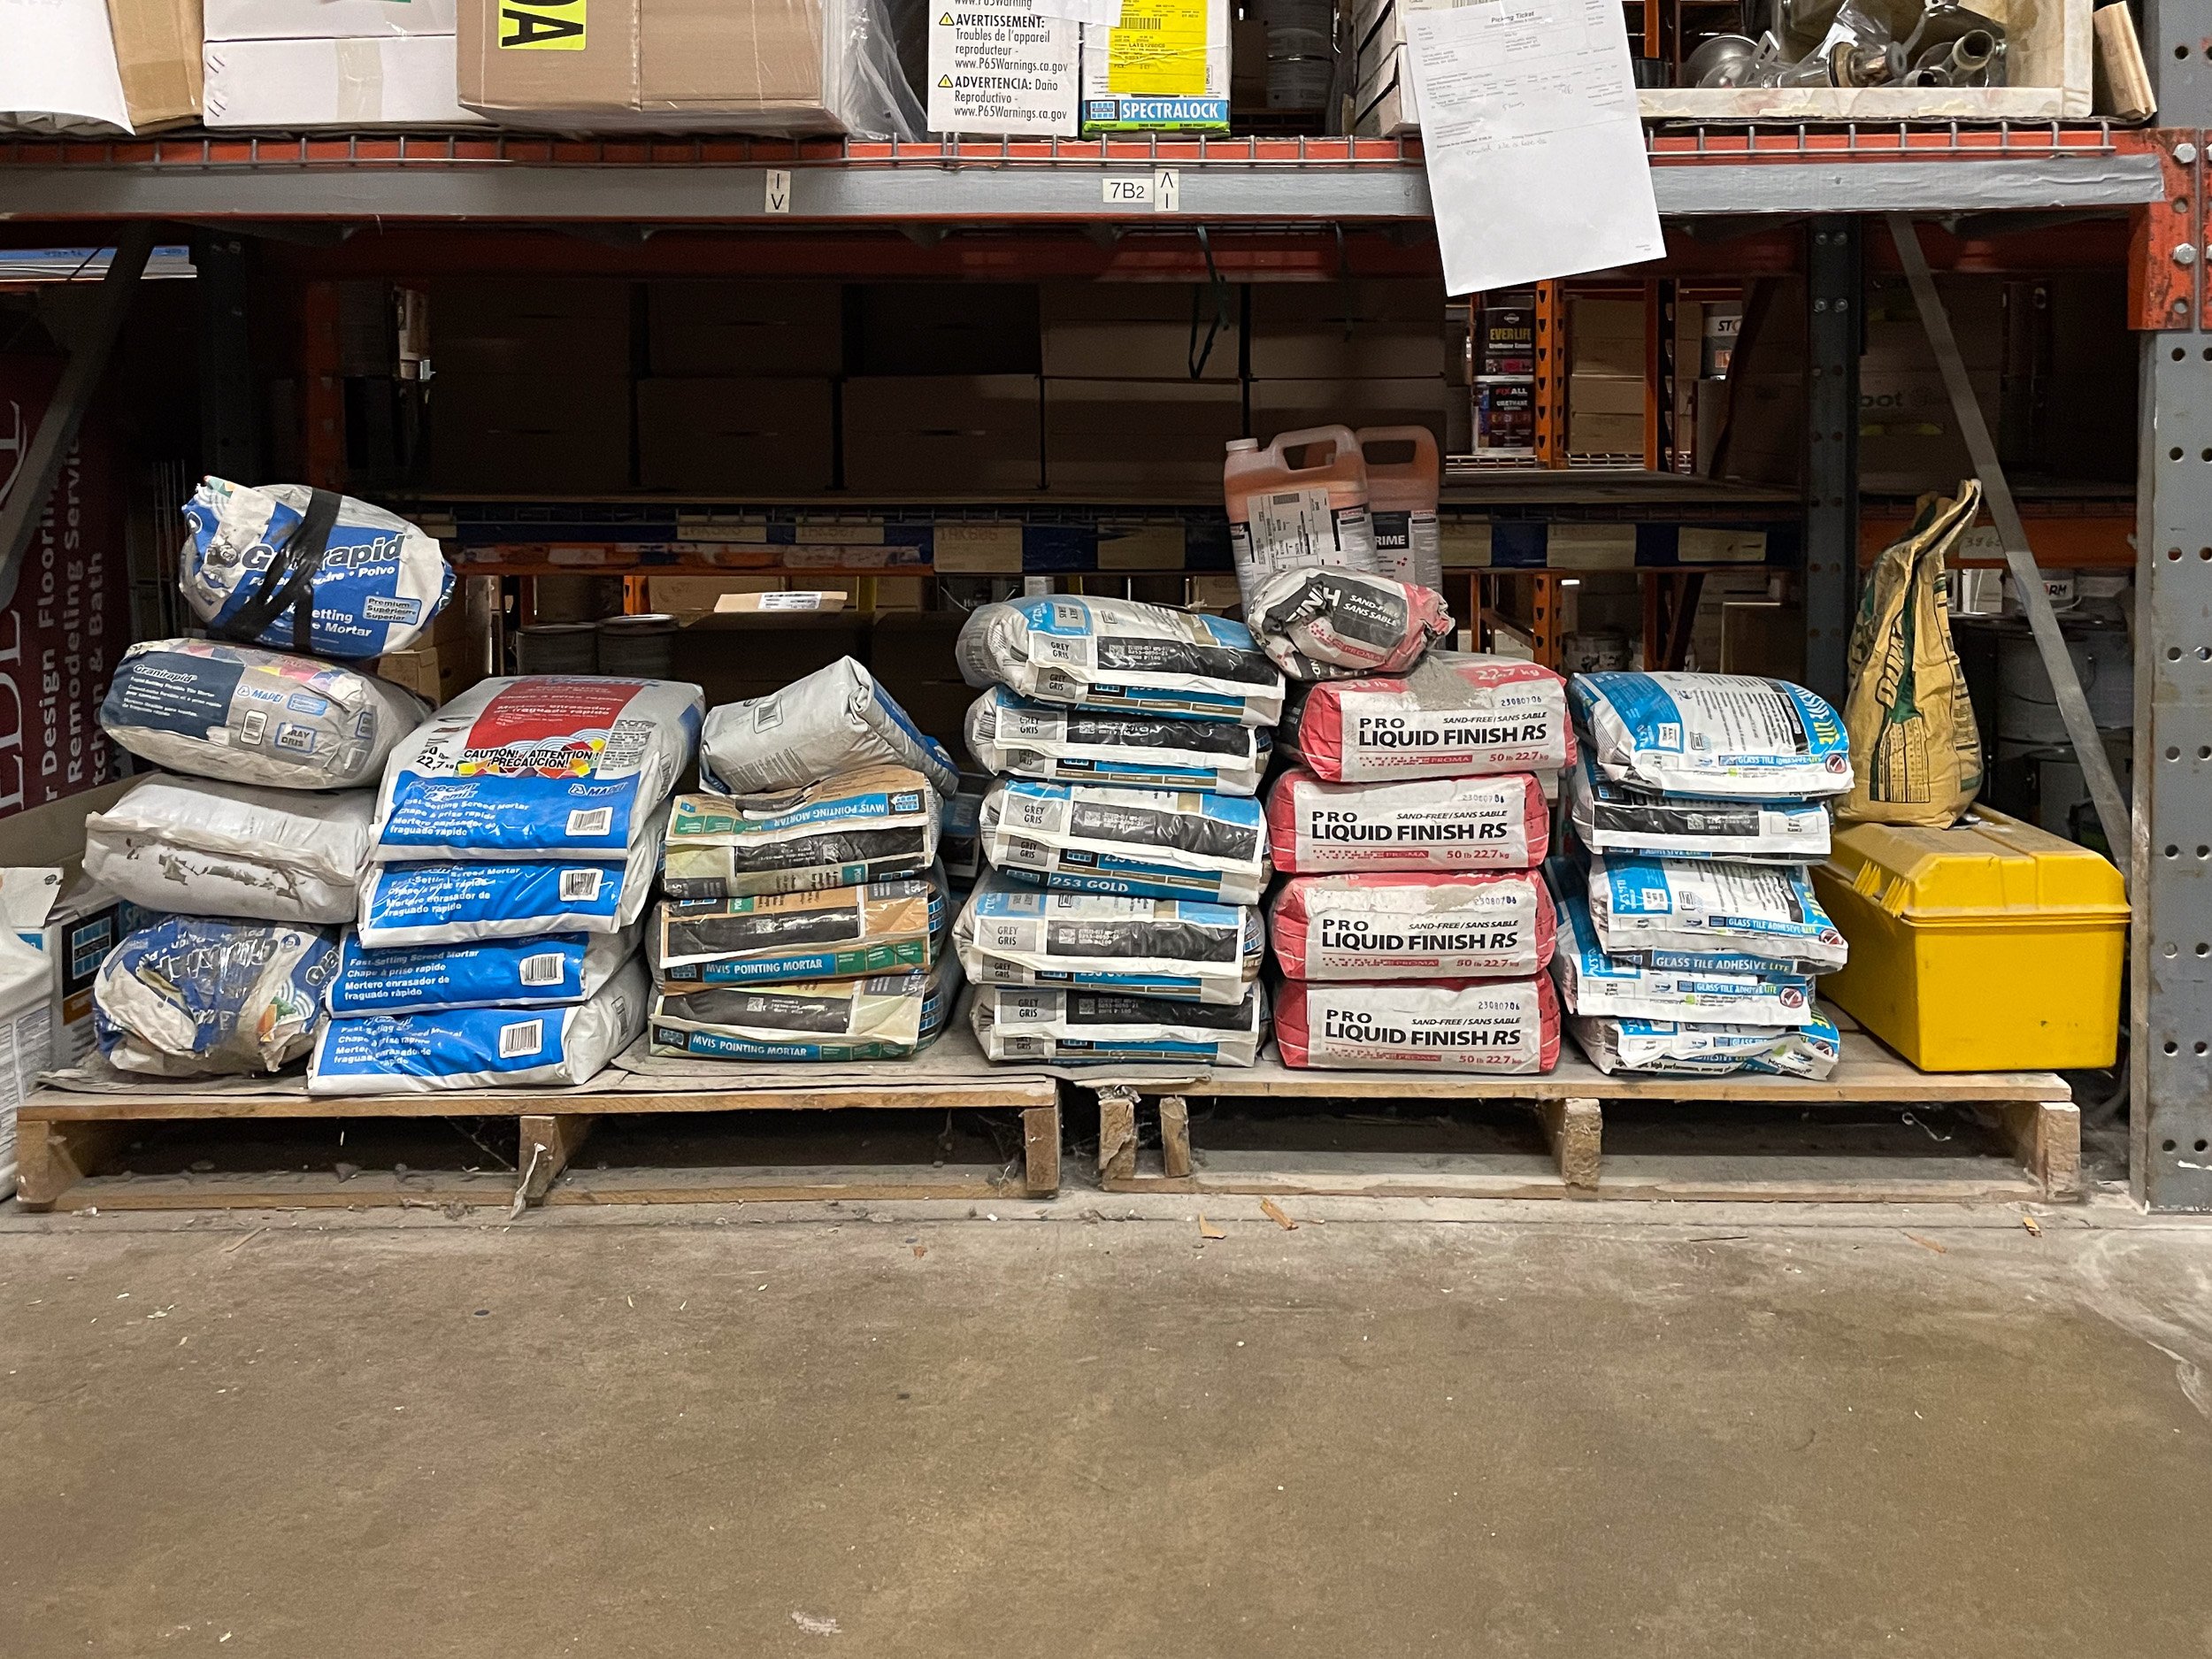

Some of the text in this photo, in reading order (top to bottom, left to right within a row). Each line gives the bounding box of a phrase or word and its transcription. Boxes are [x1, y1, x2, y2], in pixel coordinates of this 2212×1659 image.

[956, 14, 1045, 27] AVERTISSEMENT:
[956, 28, 1050, 44] Troubles de l'appareil
[956, 43, 1011, 57] reproducteur
[955, 58, 1068, 74] www.P65Warnings.ca.gov
[956, 76, 1058, 91] ADVERTENCIA: Daño
[955, 90, 1011, 104] Reproductivo
[955, 105, 1067, 121] www.P65Warnings.ca.gov
[1123, 103, 1217, 119] SPECTRALOCK
[1110, 182, 1144, 199] 7B2
[1374, 535, 1405, 546] RIME
[241, 533, 406, 572] Grapid
[357, 566, 396, 577] Polvo
[368, 598, 410, 608] Premium
[63, 441, 83, 783] Remodeling Servic
[90, 551, 104, 672] & Bath
[1343, 603, 1369, 617] SANS
[311, 610, 353, 625] etting
[325, 622, 372, 638] Mortar
[1051, 641, 1070, 651] GREY
[1052, 650, 1069, 660] GRIS
[134, 664, 196, 684] Granirapid
[1521, 668, 1540, 677] kg
[1049, 681, 1064, 690] GRIS
[251, 689, 283, 703] MAPEI
[39, 648, 59, 776] Design
[1497, 714, 1520, 723] SANS
[1522, 711, 1548, 721] SABLE
[1019, 717, 1039, 726] GREY
[1360, 718, 1405, 728] PRO
[1020, 726, 1039, 734] GRIS
[1359, 724, 1547, 748] LIQUID FINISH RS
[281, 736, 303, 748] GRIS
[464, 749, 594, 760] CAUTION! ATTENTION
[1738, 756, 1761, 764] GLASS
[773, 803, 885, 826] MVIS POINTING MORTAR
[1025, 804, 1045, 815] GREY
[1024, 814, 1042, 824] GRIS
[1312, 811, 1357, 823] PRO
[390, 825, 434, 835] fraguado
[1312, 822, 1508, 841] LIQUID FINISH RS
[1020, 841, 1037, 850] GREY
[1019, 849, 1035, 858] GRIS
[487, 867, 520, 876] Mortar
[1053, 877, 1129, 893] 253 GOLD
[1323, 919, 1369, 931] PRO
[1729, 918, 1751, 928] GLASS
[1753, 919, 1767, 929] TILE
[997, 926, 1018, 935] GREY
[997, 936, 1017, 946] GRIS
[1322, 932, 1517, 951] LIQUID FINISH RS
[447, 950, 480, 959] Mortar
[706, 959, 822, 974] MVIS POINTING MORTAR
[994, 962, 1010, 971] GREY
[1656, 956, 1790, 972] GLASS TILE ADHESIVE LITE
[995, 970, 1010, 979] GRIS
[345, 980, 383, 991] Mortero
[386, 977, 435, 987] enrasador
[1697, 983, 1718, 992] GLASS
[344, 990, 388, 1001] fraguado
[1018, 999, 1039, 1008] GREY
[1019, 1009, 1038, 1018] GRIS
[1326, 1009, 1372, 1024] PRO
[1325, 1022, 1521, 1046] LIQUID FINISH RS
[693, 1034, 807, 1056] MVIS POINTING MORTAR
